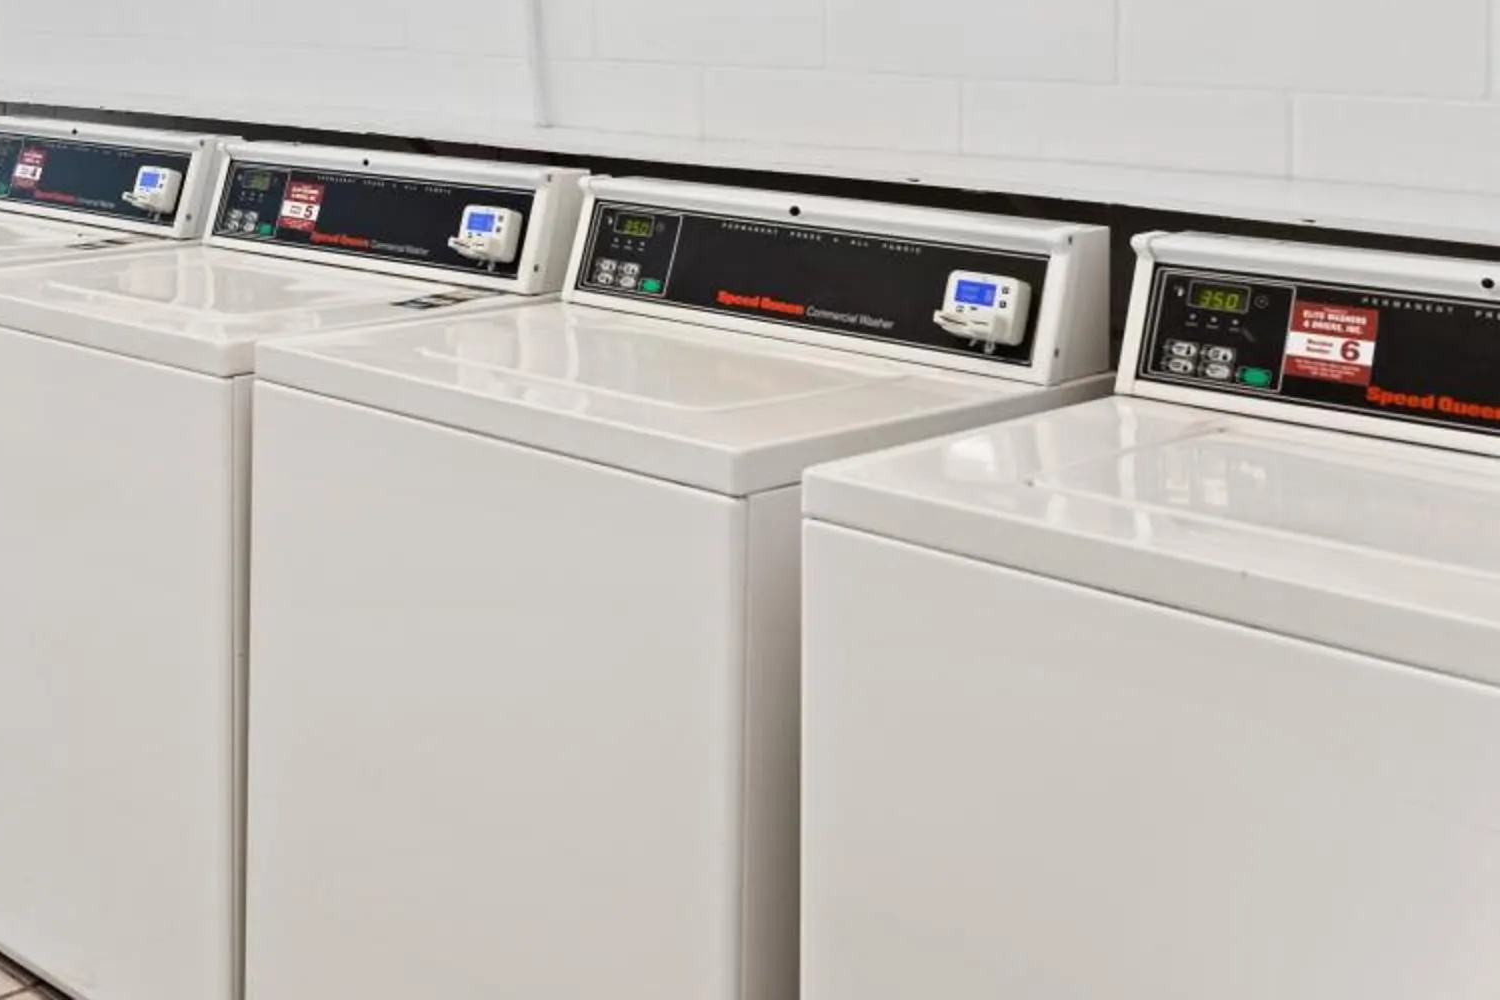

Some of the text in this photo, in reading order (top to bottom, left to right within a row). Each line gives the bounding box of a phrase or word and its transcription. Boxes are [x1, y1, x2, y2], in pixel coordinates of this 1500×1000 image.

[303, 205, 313, 218] 5
[716, 290, 896, 329] Speed Queen Commercial Washer
[1340, 340, 1361, 361] 6
[1366, 386, 1436, 410] Speed
